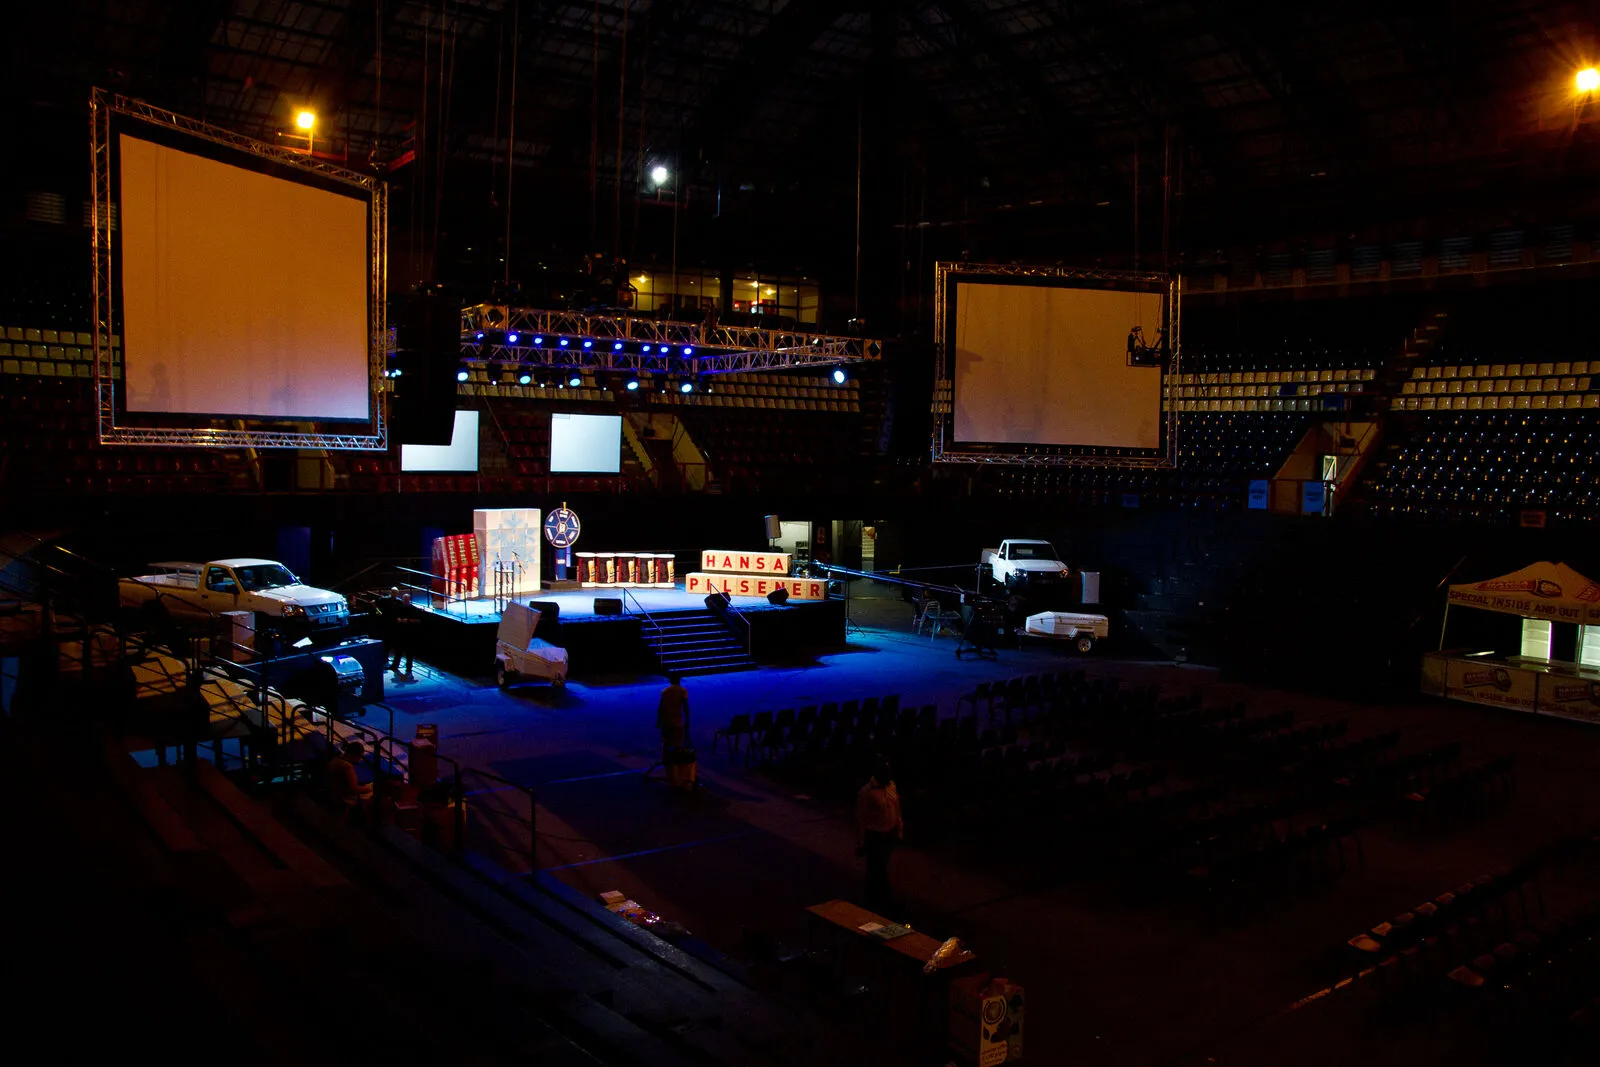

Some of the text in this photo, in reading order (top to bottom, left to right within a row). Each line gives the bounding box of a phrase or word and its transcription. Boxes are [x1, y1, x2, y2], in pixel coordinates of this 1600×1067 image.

[706, 555, 784, 571] HANSA
[689, 577, 820, 597] PILSENER
[1449, 590, 1489, 605] SPECIAL
[1492, 597, 1531, 611] INSIDE
[1534, 604, 1556, 615] AND
[1559, 608, 1580, 618] OUT
